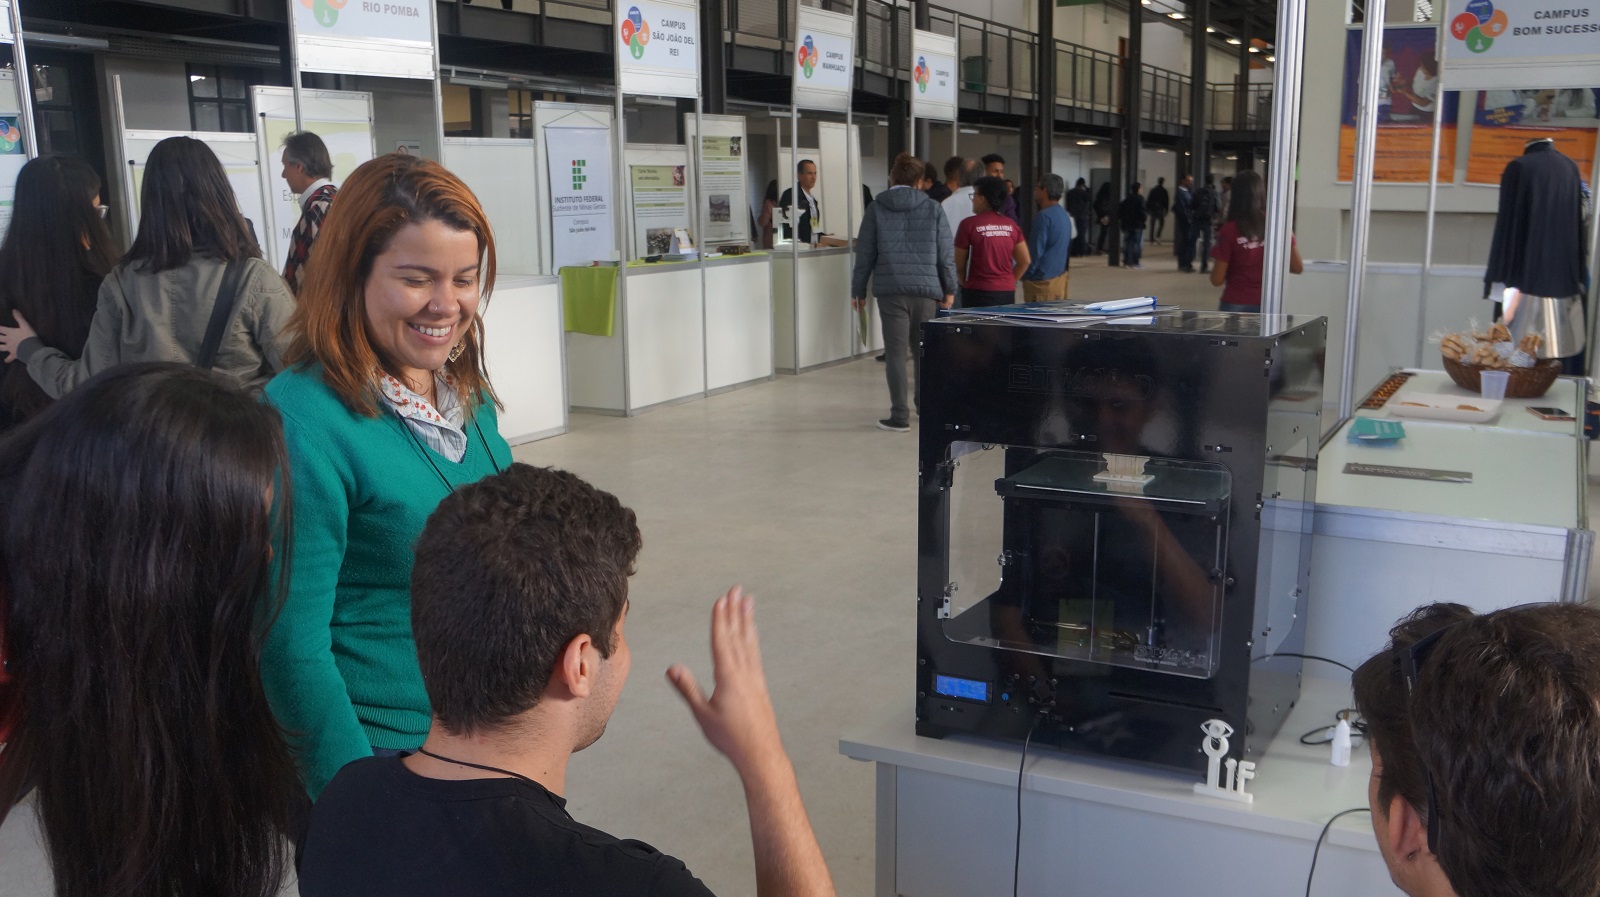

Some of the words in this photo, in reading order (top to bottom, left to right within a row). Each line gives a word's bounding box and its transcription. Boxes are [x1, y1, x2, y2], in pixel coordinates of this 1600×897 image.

[362, 1, 381, 13] RIO
[384, 4, 420, 18] POMBA
[1533, 8, 1590, 20] CAMPUS
[661, 19, 686, 30] CAMPUS
[1513, 26, 1542, 36] BOM
[652, 31, 665, 41] SÃO
[666, 34, 682, 43] JOÃO
[683, 37, 695, 45] DEL
[669, 48, 679, 57] REI
[826, 51, 844, 61] CAMPUS
[554, 196, 582, 204] INSTITUTO
[583, 195, 604, 203] FEDERAL
